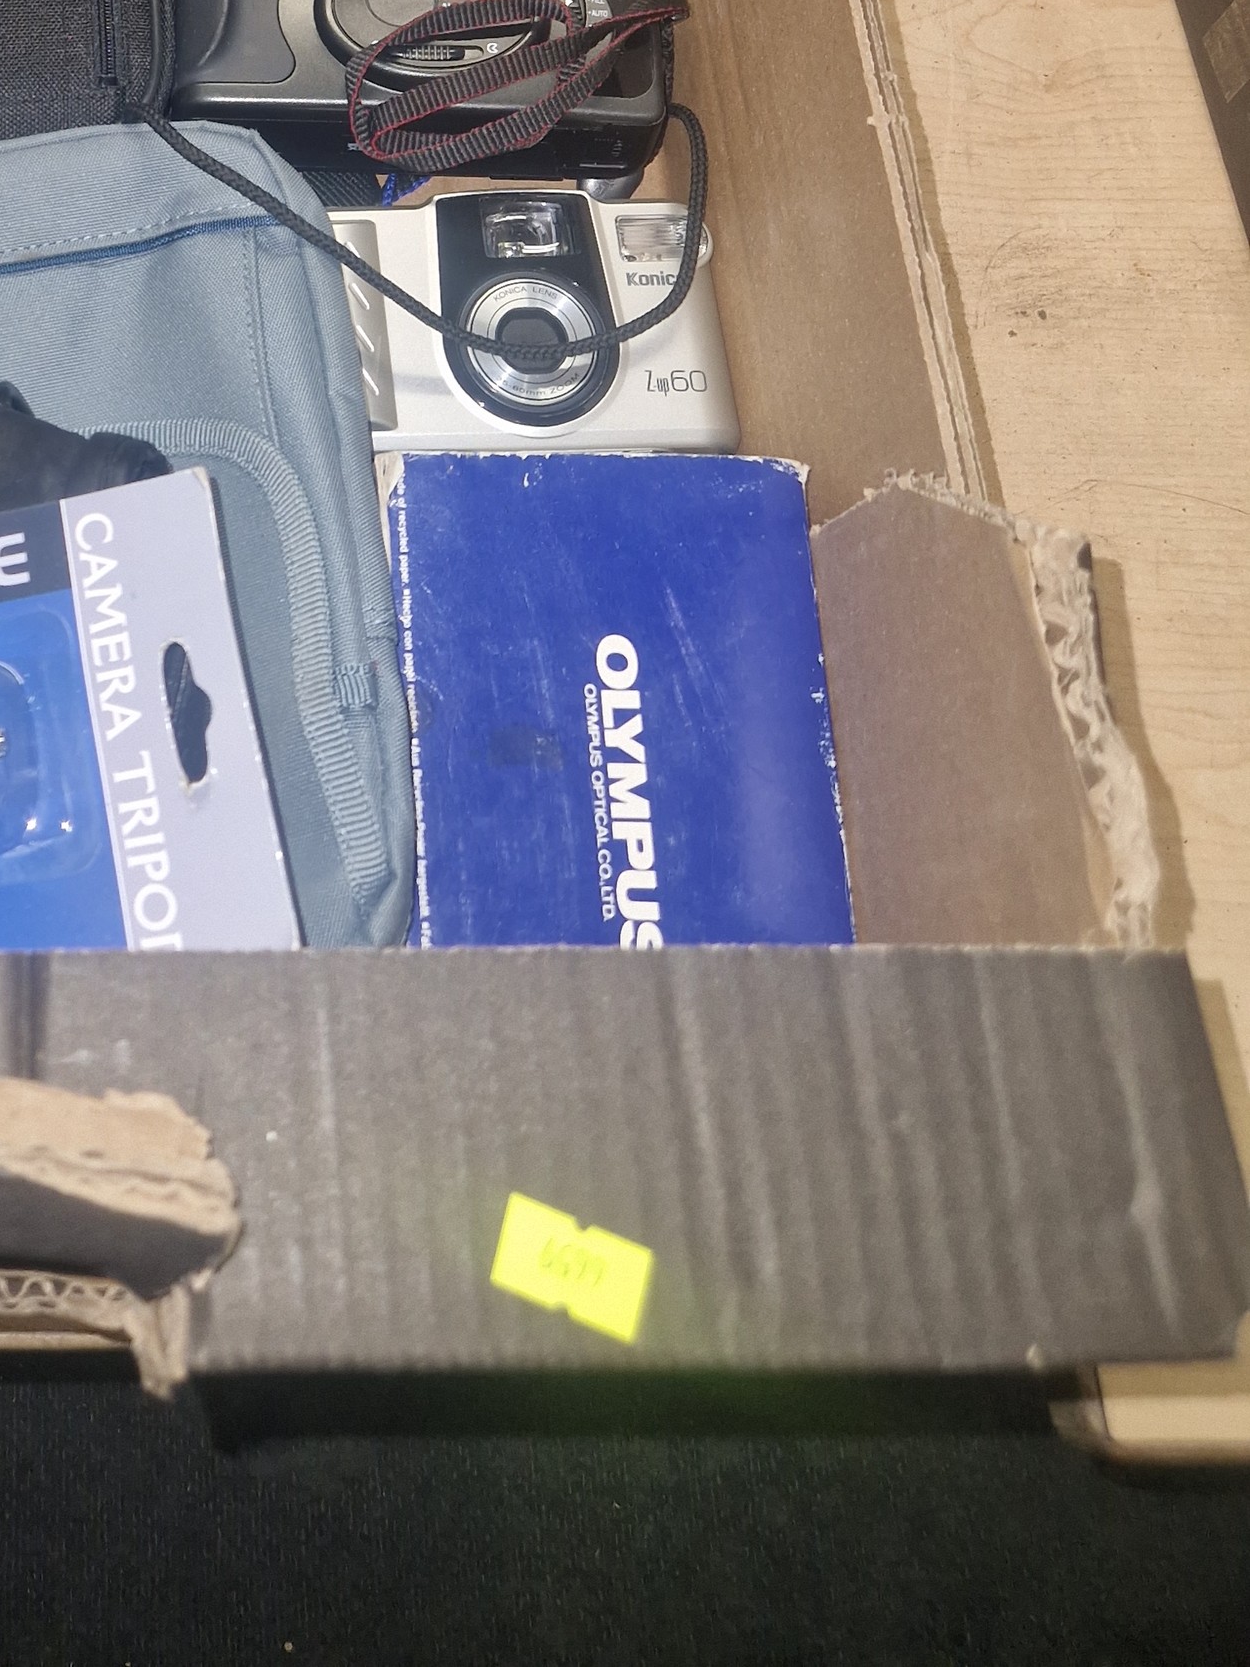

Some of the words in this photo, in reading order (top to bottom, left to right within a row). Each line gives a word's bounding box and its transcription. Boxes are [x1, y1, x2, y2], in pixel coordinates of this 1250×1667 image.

[591, 10, 609, 18] AUTO
[626, 272, 678, 287] Konic
[493, 286, 528, 302] KONICA
[532, 286, 558, 300] LENS
[550, 373, 580, 395] ZOOM
[396, 474, 407, 496] ade
[397, 509, 410, 553] recycled
[399, 554, 411, 586] paper.
[70, 511, 143, 742] CAMERA
[404, 630, 413, 651] con
[583, 683, 604, 768] OLYMPUS
[596, 633, 665, 951] OLYMPUS
[591, 770, 609, 847] OPTICAL
